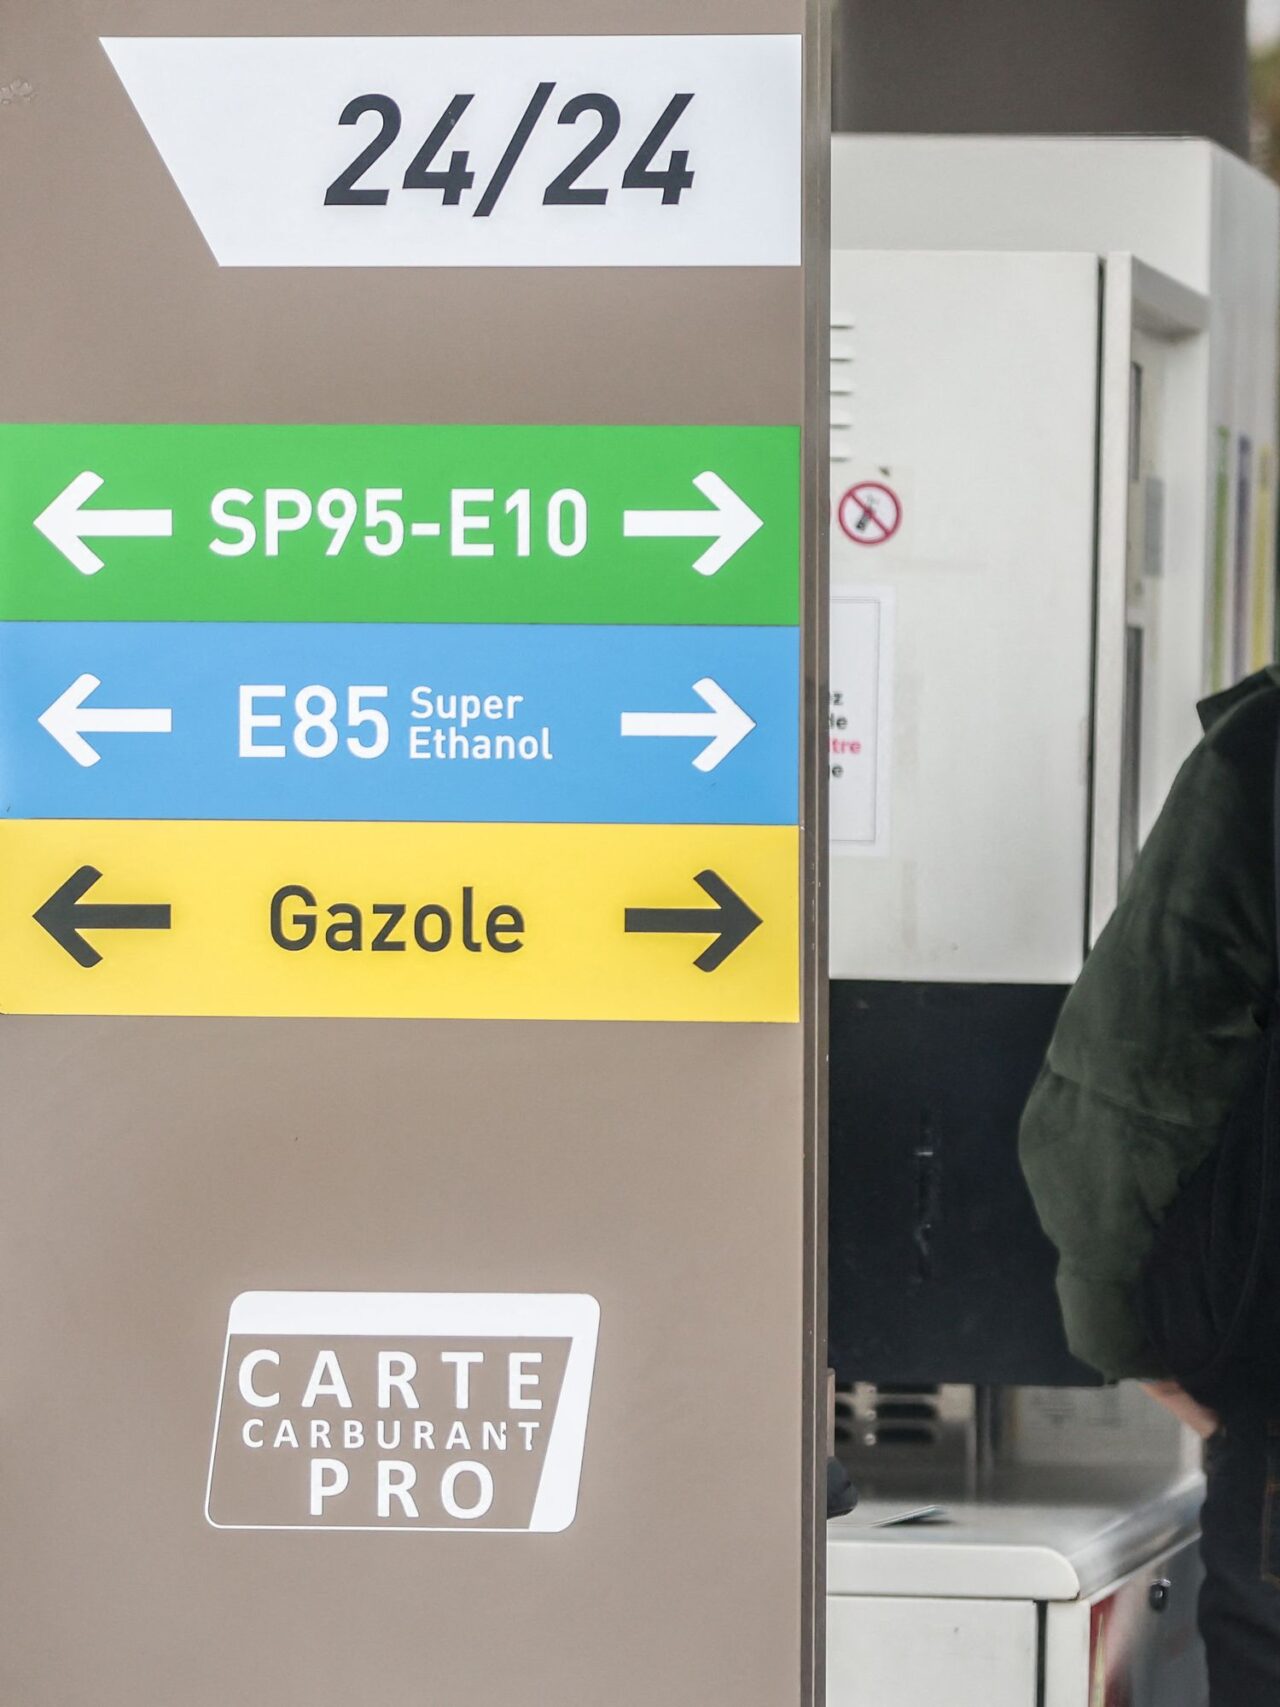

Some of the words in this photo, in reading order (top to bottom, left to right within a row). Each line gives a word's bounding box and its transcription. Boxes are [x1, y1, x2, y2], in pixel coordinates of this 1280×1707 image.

[323, 81, 695, 217] 24/24
[208, 487, 587, 557] SP95-E10
[238, 684, 389, 759] E85
[410, 686, 524, 726] Super
[410, 725, 553, 759] Ethanol
[270, 884, 525, 954] Gazole
[238, 1349, 543, 1410] CARTE
[242, 1418, 540, 1451] CARBURANT
[310, 1458, 494, 1520] PRO
